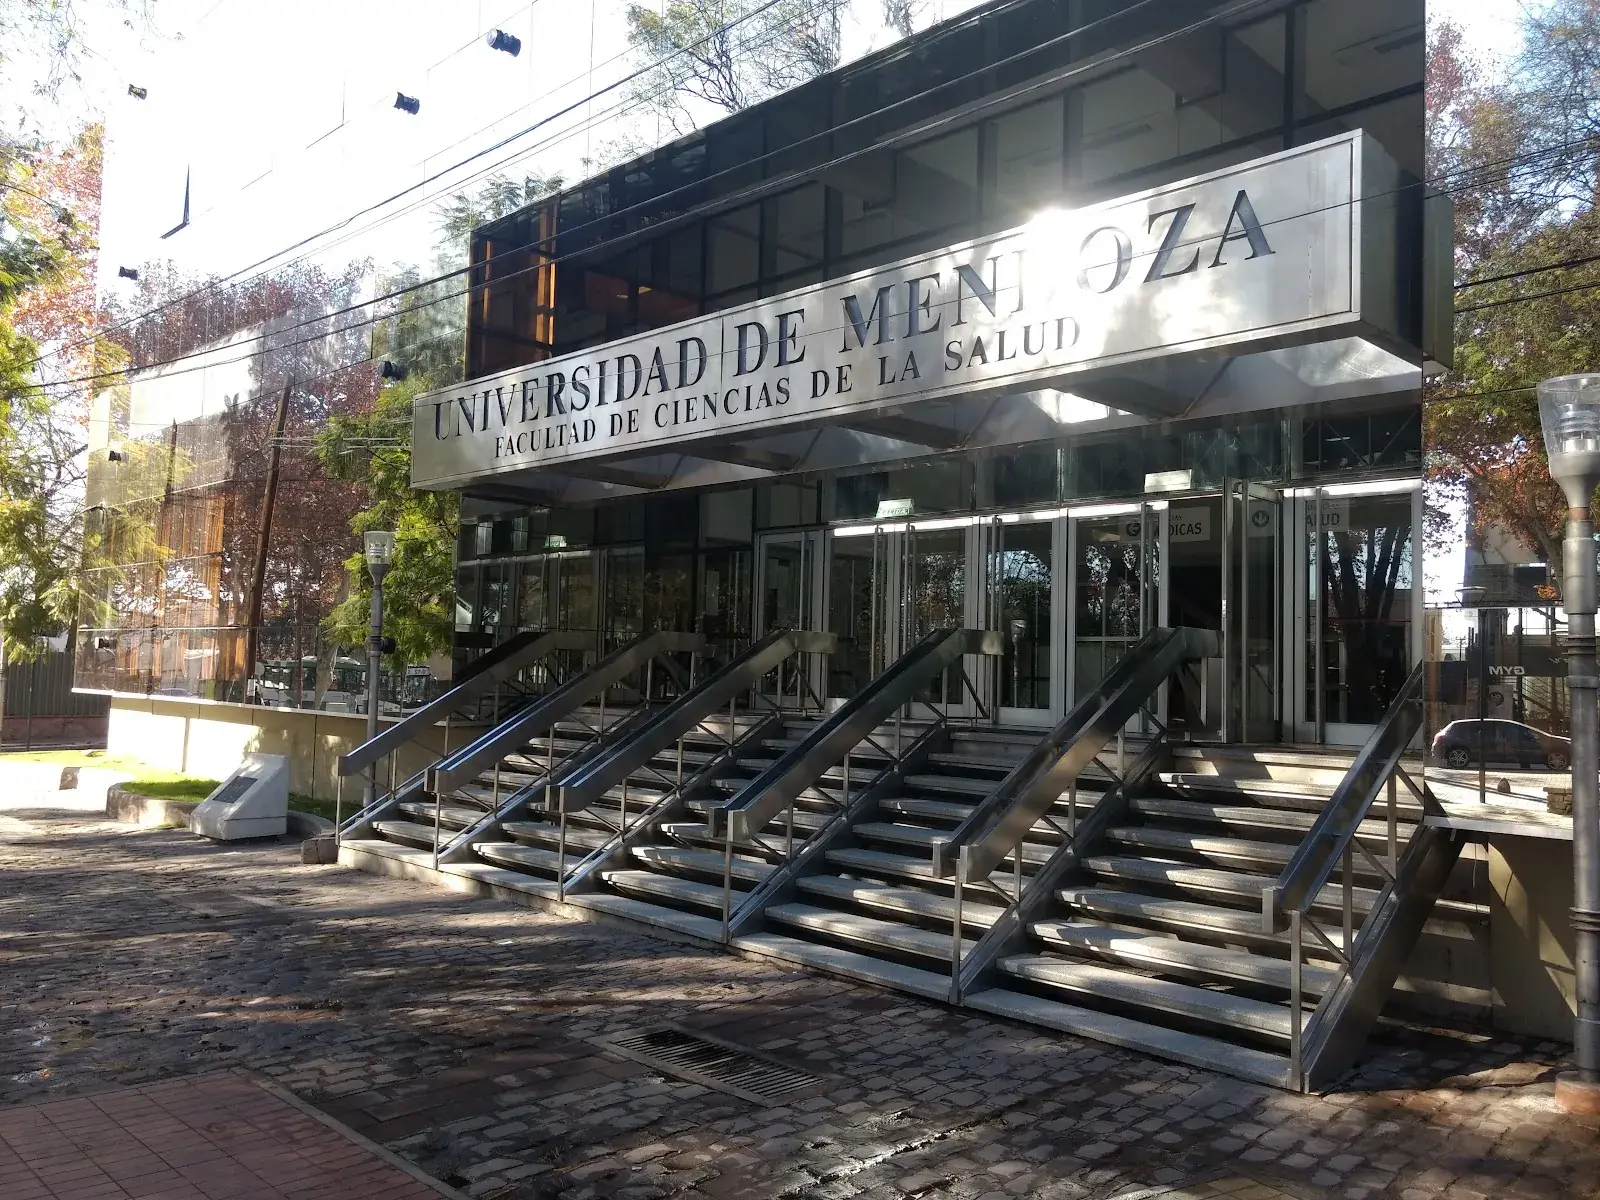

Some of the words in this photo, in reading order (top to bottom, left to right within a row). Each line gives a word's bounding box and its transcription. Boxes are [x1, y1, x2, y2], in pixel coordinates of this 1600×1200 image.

[434, 336, 708, 441] UNIVERSIDAD
[734, 307, 806, 377] DE
[494, 421, 597, 458] FACULTAD
[609, 408, 640, 437] DE
[654, 377, 791, 425] CIENCIAS
[810, 364, 854, 398] DE
[879, 350, 922, 385] LA
[944, 315, 1081, 372] SALUD
